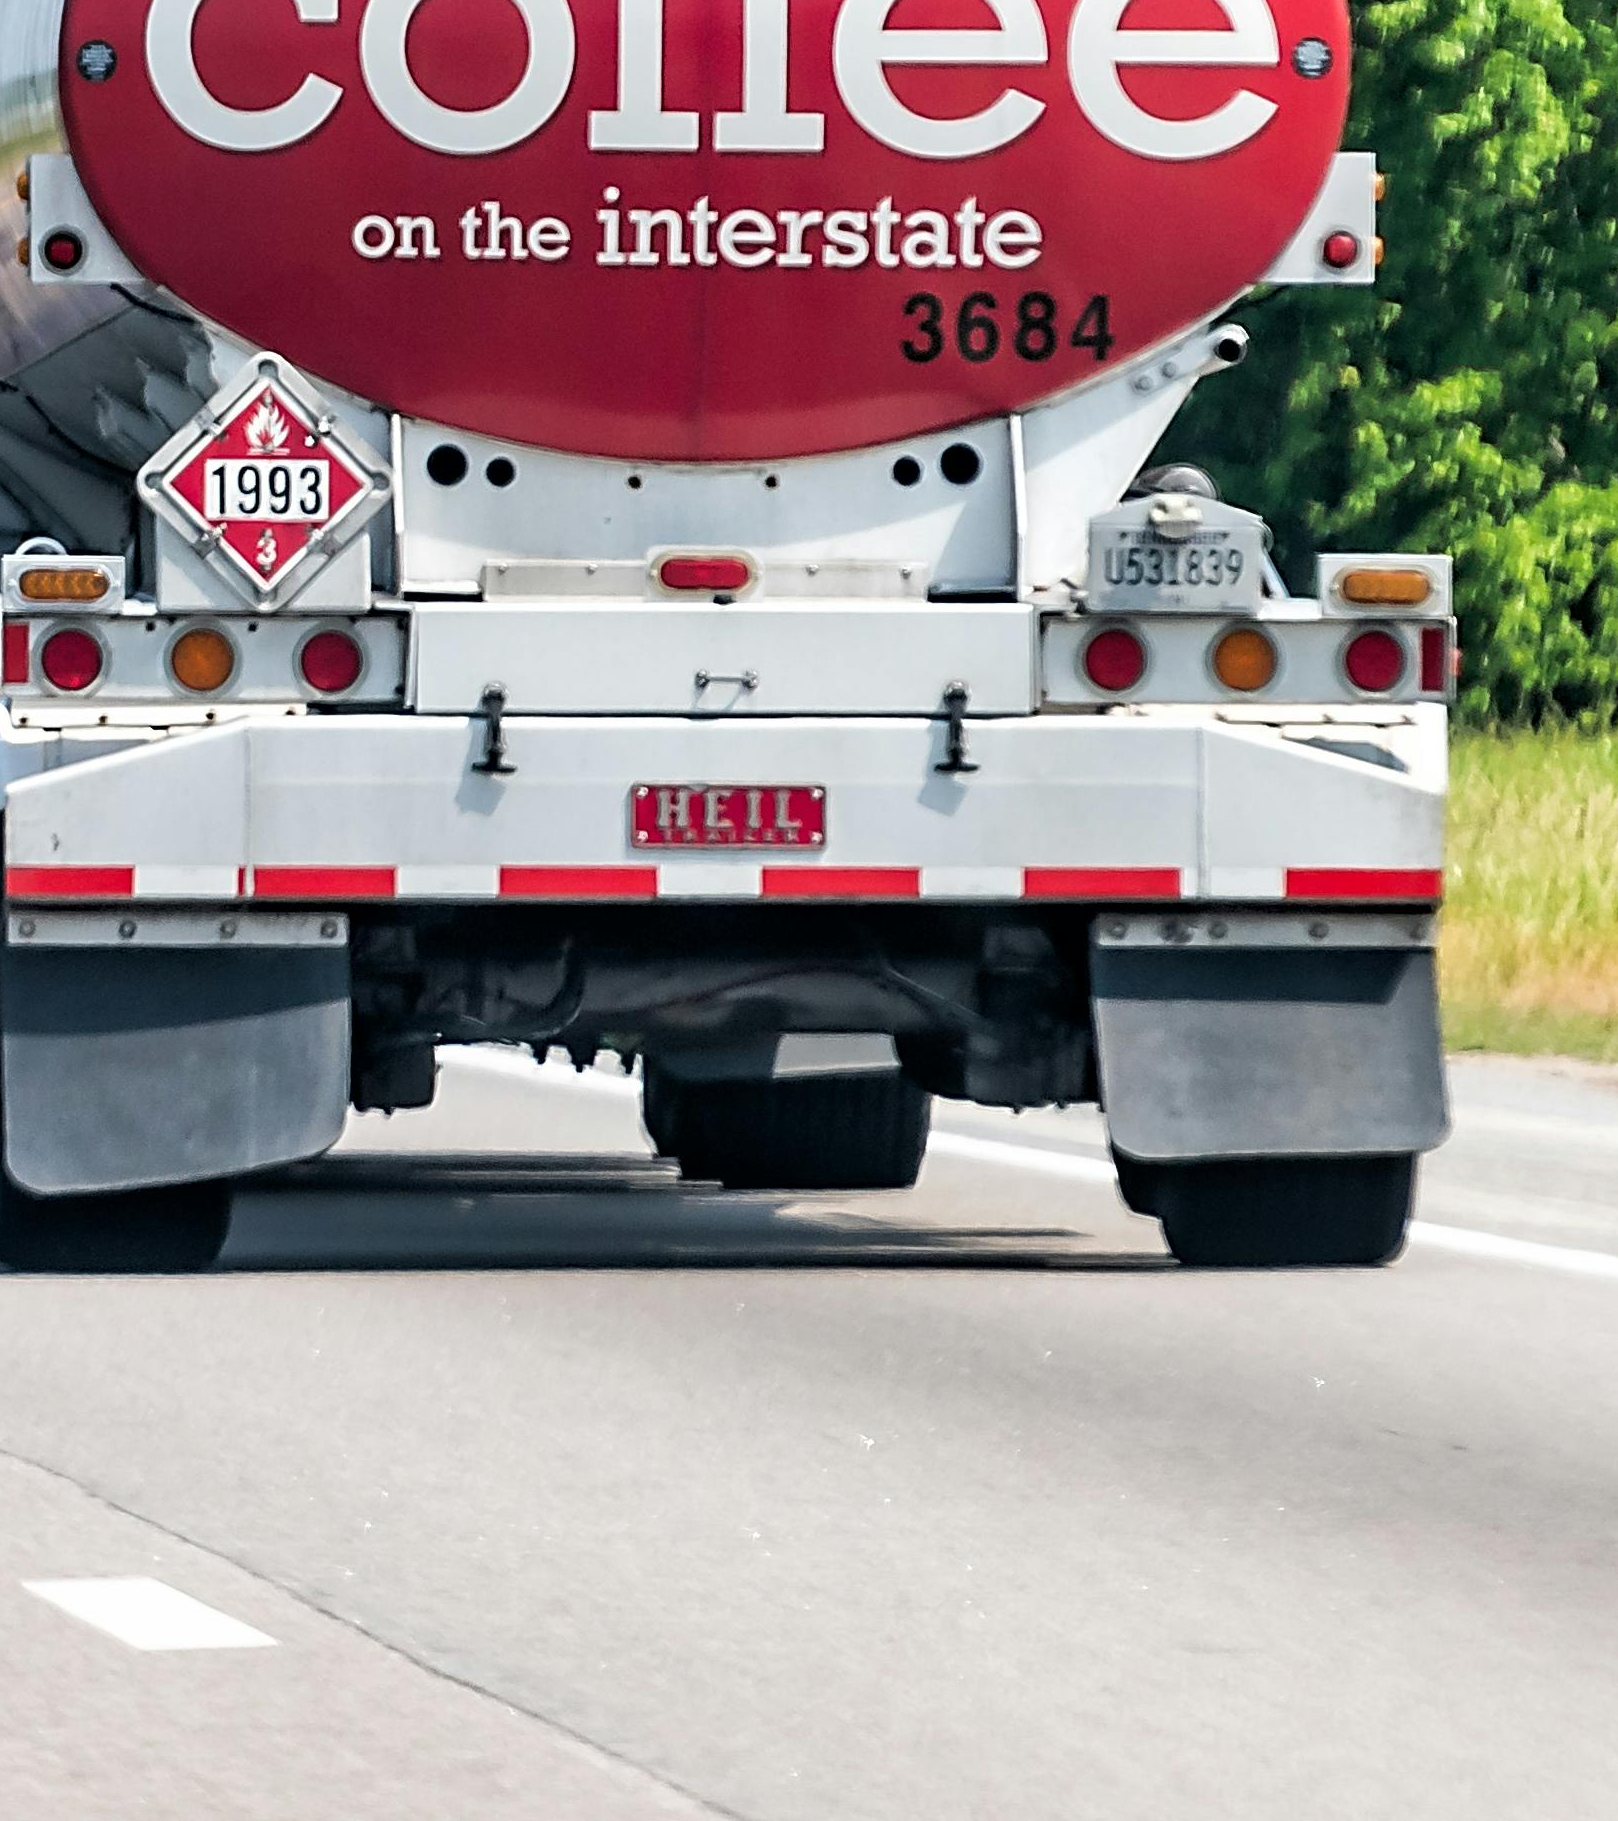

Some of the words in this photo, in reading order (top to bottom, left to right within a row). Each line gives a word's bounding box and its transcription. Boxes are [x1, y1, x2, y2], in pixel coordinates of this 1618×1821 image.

[351, 215, 441, 259] on
[460, 201, 571, 260] the
[595, 186, 1043, 268] interstate
[900, 290, 1115, 364] 3684
[212, 465, 322, 515] 1993
[256, 537, 277, 565] 3
[1104, 547, 1244, 586] U531839
[657, 788, 803, 829] HEIL
